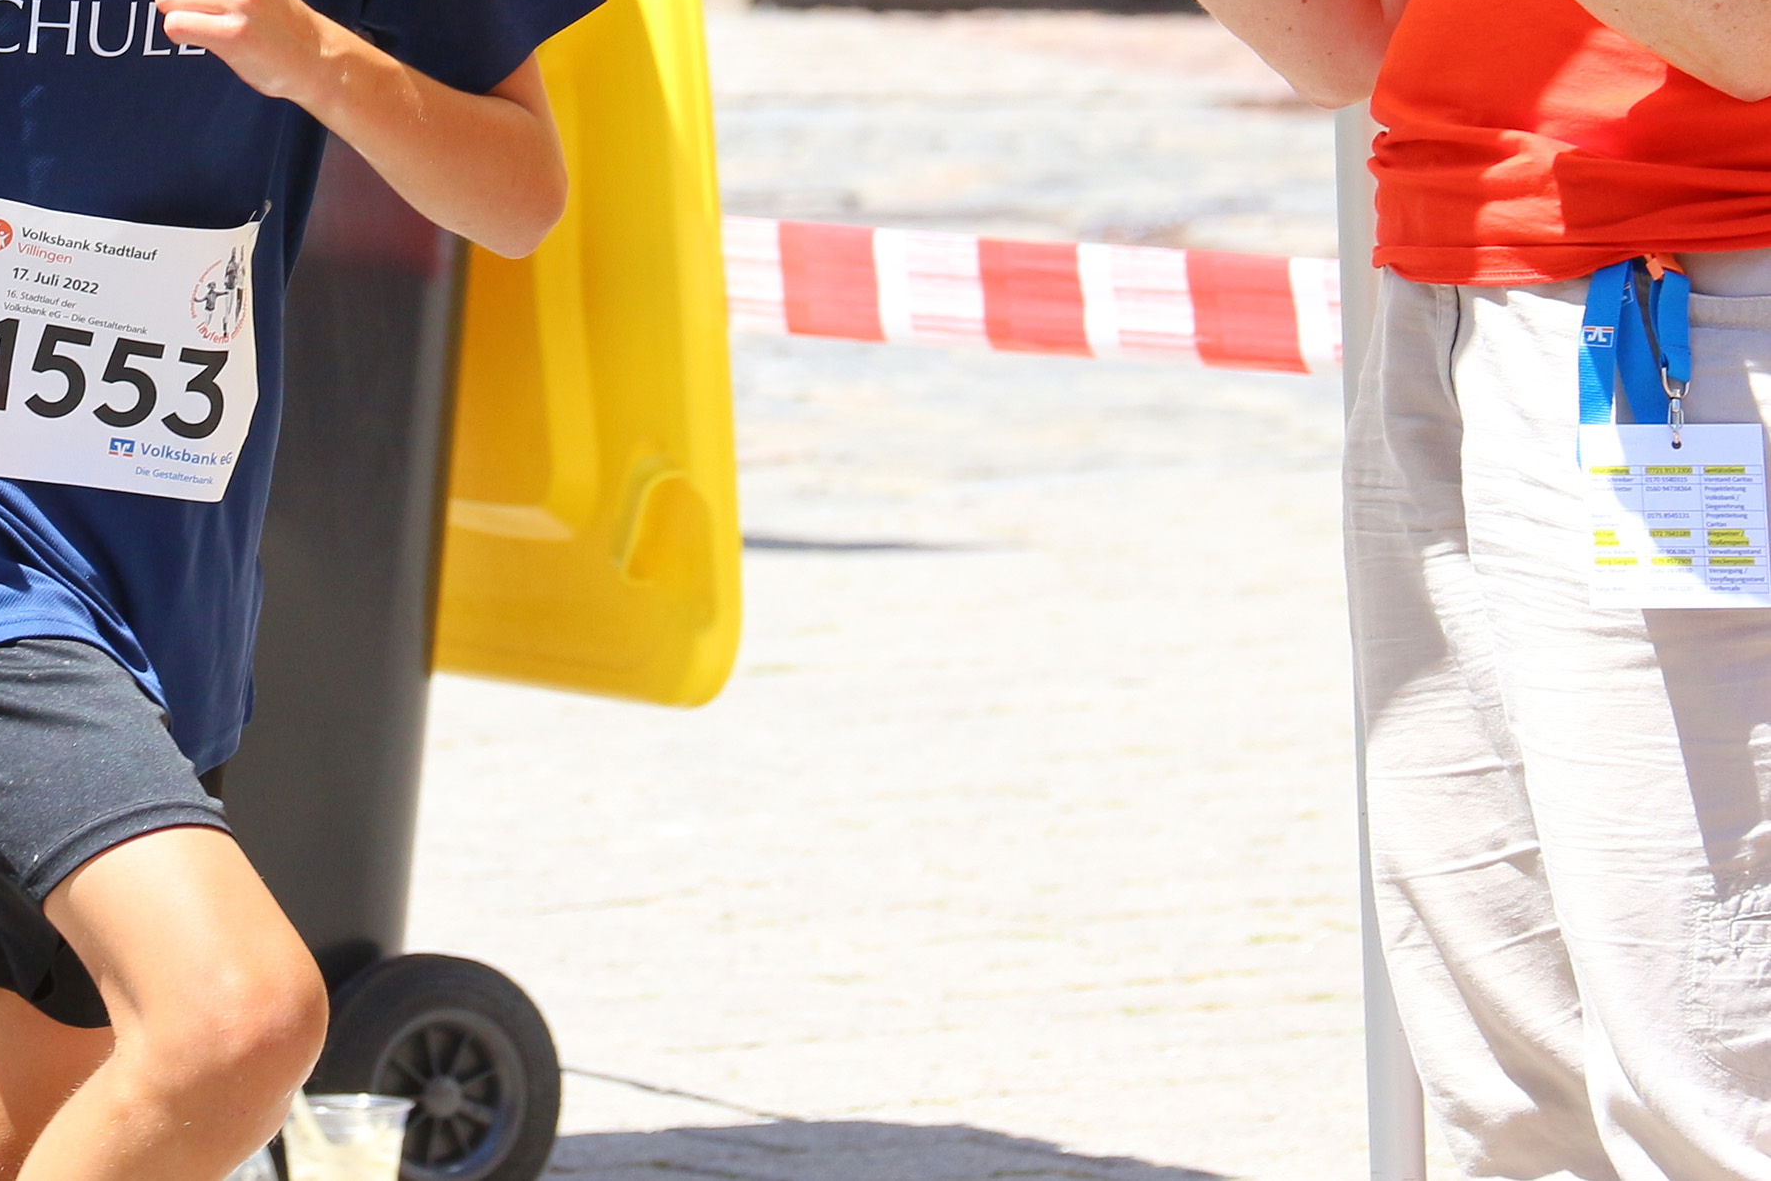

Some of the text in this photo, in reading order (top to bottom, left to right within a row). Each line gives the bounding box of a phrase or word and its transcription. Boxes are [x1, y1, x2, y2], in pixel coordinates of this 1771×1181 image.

[17, 242, 73, 264] Villingen
[21, 226, 158, 261] Volksbank Stadtlauf
[12, 267, 99, 294] 17. Juli 2022
[6, 289, 77, 309] 16. Stadtlauf der
[3, 301, 46, 317] Volksbank
[48, 309, 61, 319] eG
[70, 313, 86, 323] Die
[88, 317, 147, 335] Gestalterbank
[140, 442, 217, 465] Volksbank
[135, 466, 214, 485] Die Gestalterbank
